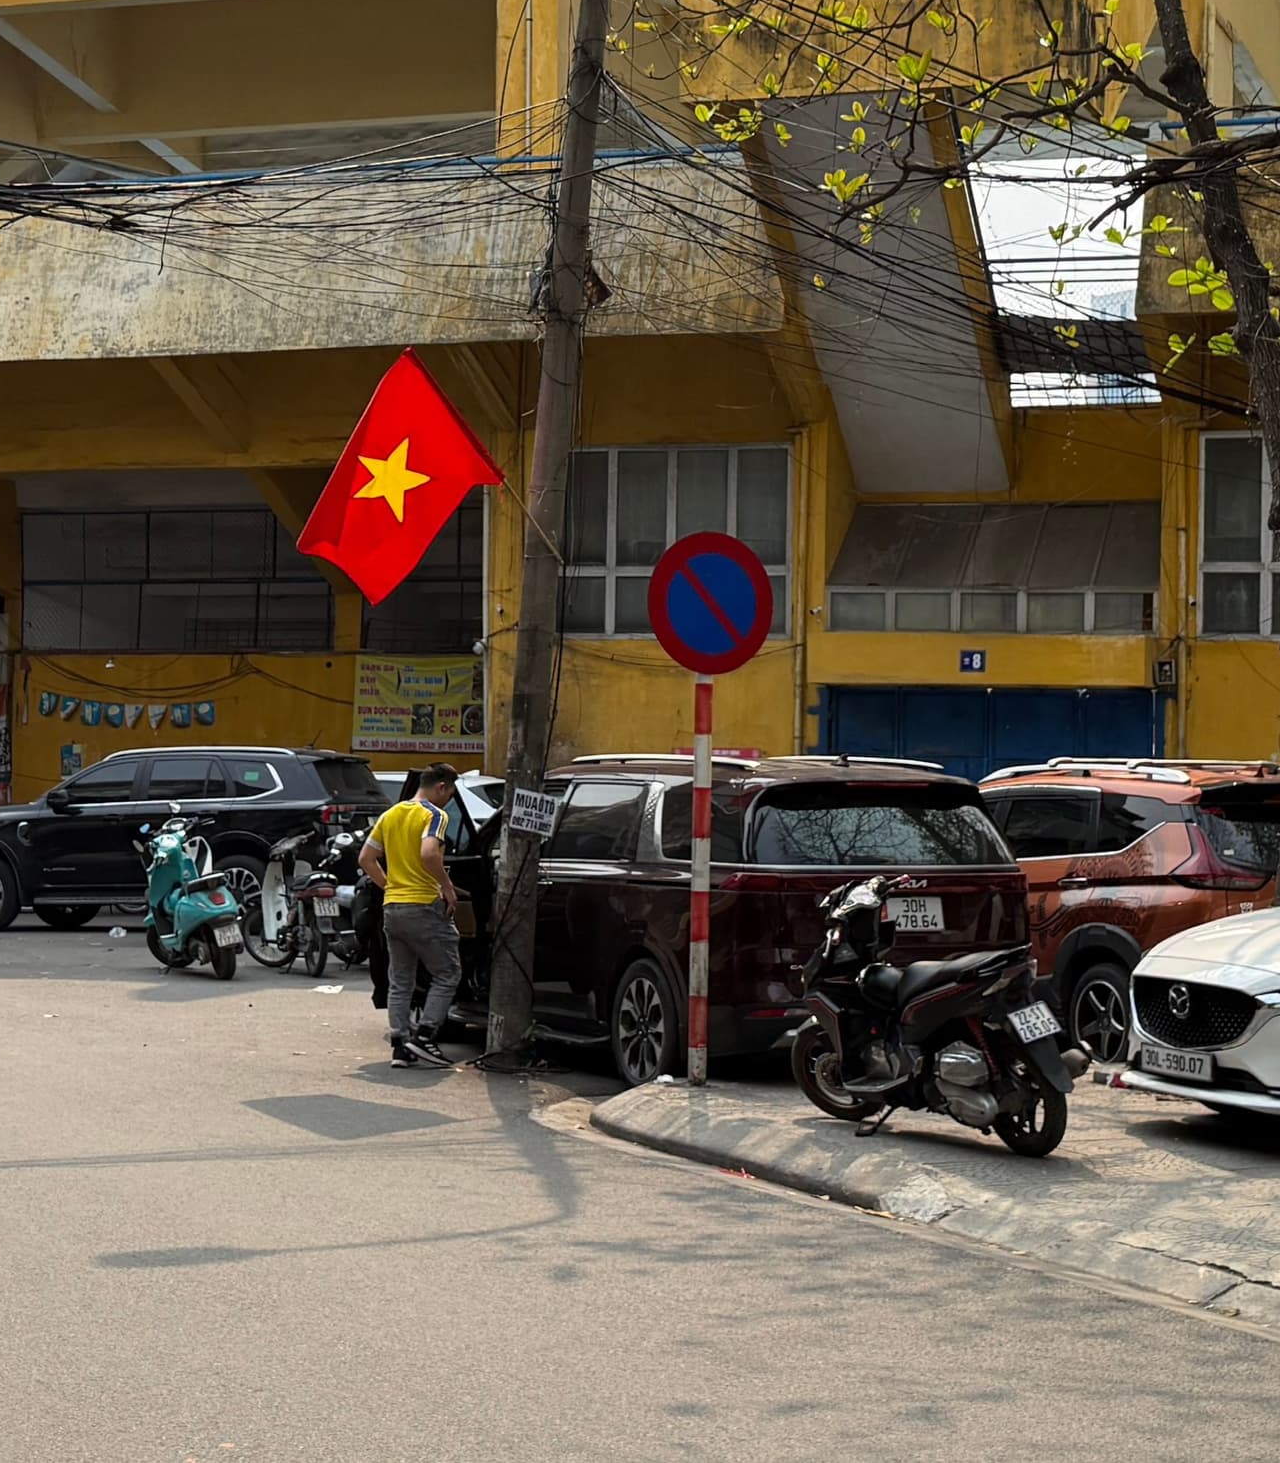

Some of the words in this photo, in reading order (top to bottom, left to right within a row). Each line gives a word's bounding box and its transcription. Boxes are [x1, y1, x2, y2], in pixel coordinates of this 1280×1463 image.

[972, 653, 981, 669] 8
[901, 899, 927, 913] 30H
[895, 914, 938, 929] 478.64
[1019, 1018, 1057, 1041] 285.05
[1145, 1049, 1204, 1075] 30L-590.07
